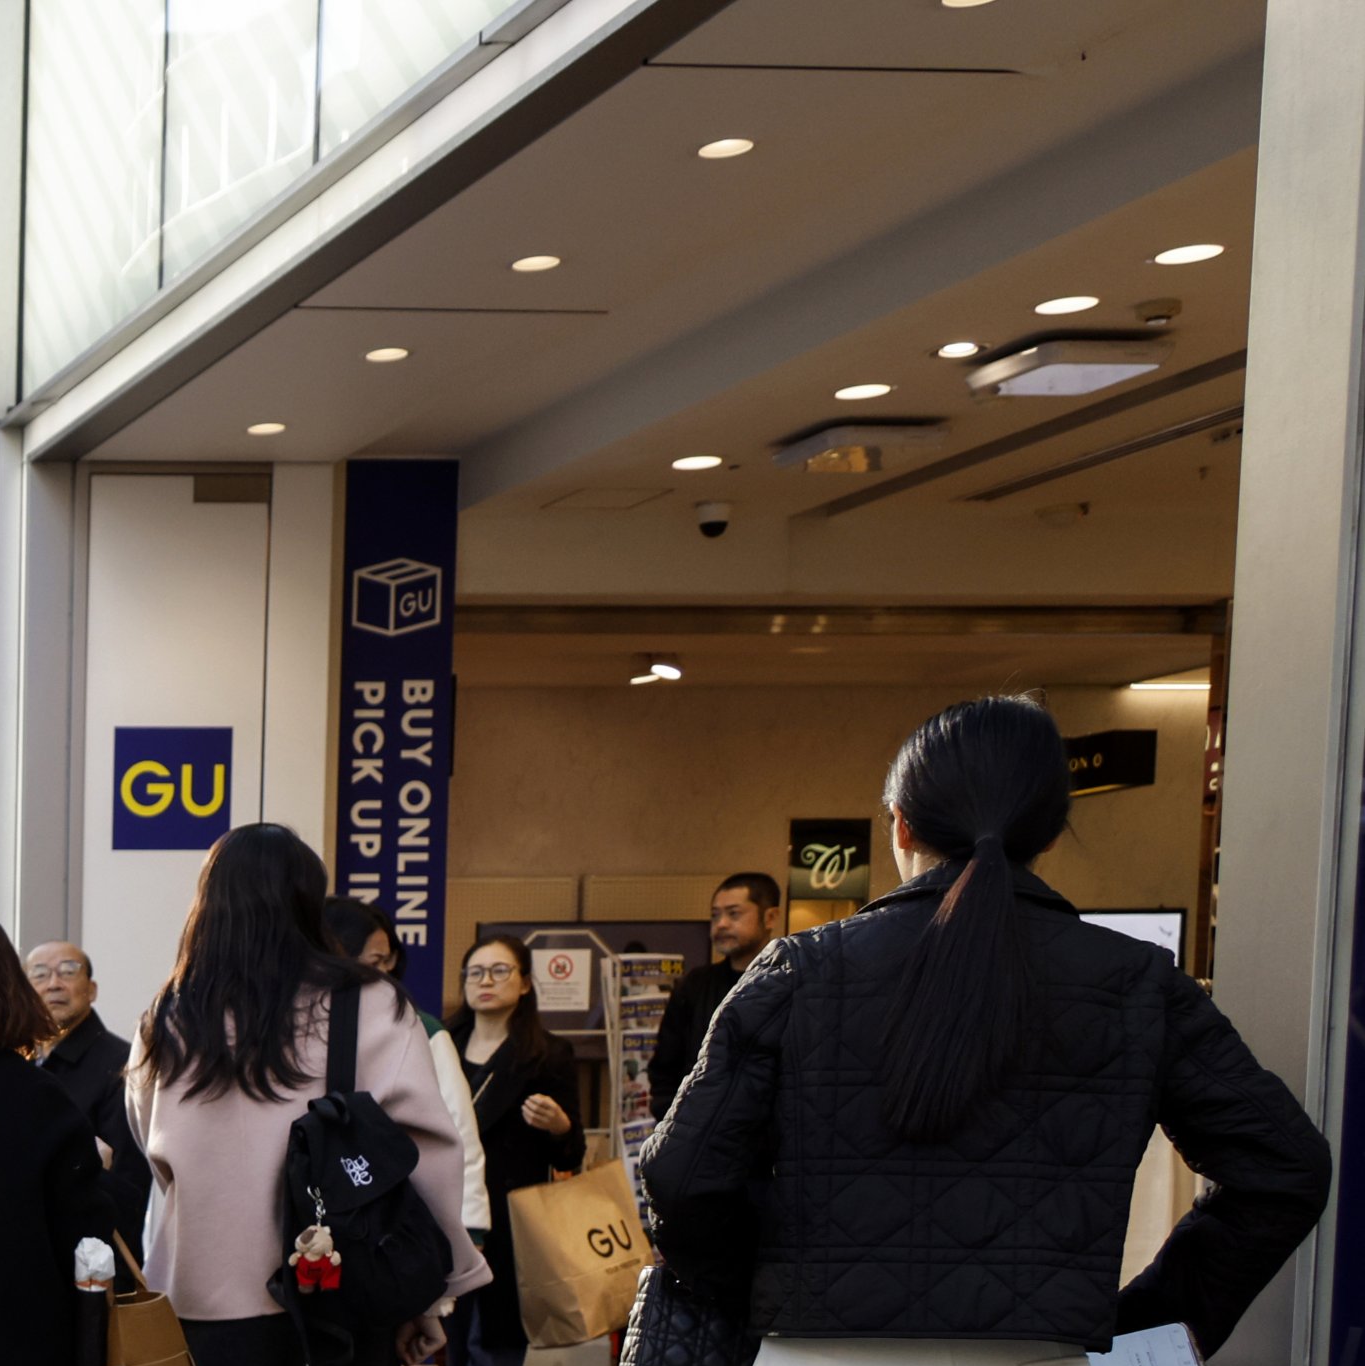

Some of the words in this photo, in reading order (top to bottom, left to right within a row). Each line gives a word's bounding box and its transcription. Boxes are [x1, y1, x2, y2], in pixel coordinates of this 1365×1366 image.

[399, 588, 433, 617] GU
[351, 681, 386, 784] PICK
[400, 680, 434, 767] BUY
[120, 760, 225, 817] GU
[349, 799, 382, 858] UP
[395, 780, 432, 947] ONLINE
[587, 1219, 633, 1258] GU
